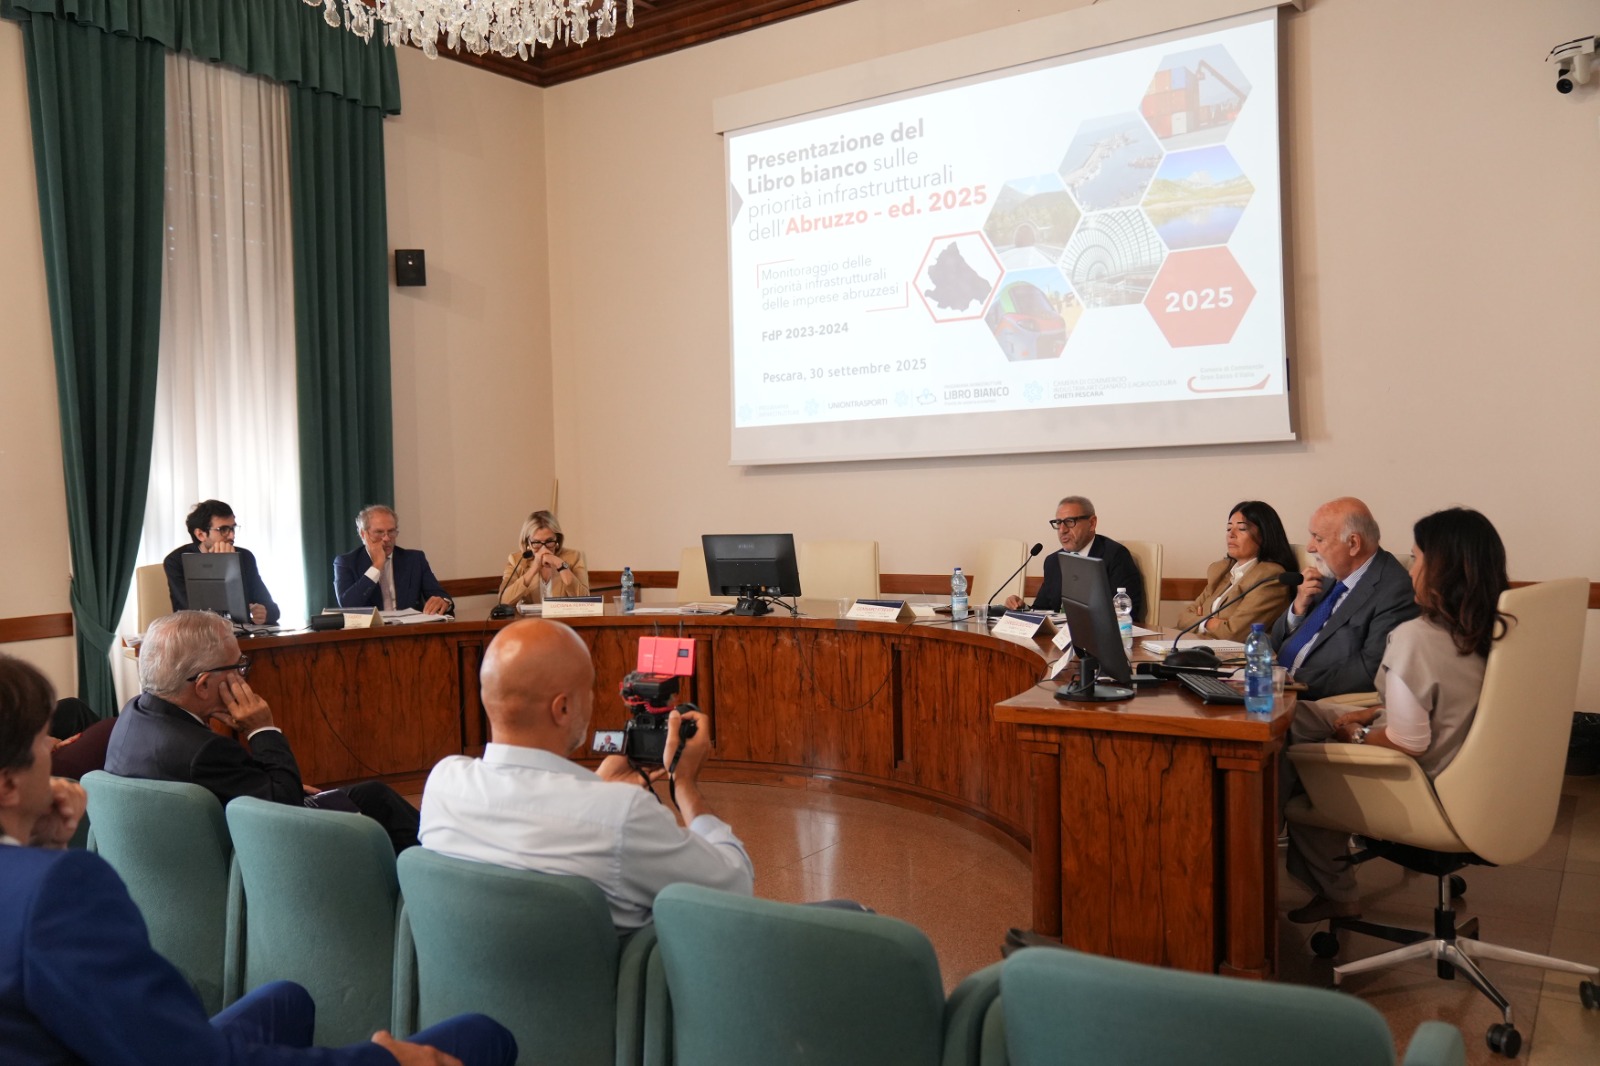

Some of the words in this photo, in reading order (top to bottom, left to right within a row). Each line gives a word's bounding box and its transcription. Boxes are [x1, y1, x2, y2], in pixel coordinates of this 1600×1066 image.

[747, 131, 885, 172] Presentazione
[891, 118, 924, 143] del
[748, 173, 795, 195] Libro
[801, 160, 868, 186] bianco
[873, 147, 919, 172] sulle
[748, 190, 812, 223] priorità
[818, 165, 953, 206] infrastrutturali
[888, 195, 922, 218] ed.
[928, 185, 988, 212] 2025
[761, 260, 839, 281] Monitoraggio
[842, 254, 872, 270] delle
[762, 281, 802, 299] priorità
[805, 268, 887, 290] infrastrutturali
[762, 296, 790, 311] delle
[792, 291, 839, 309] imprese
[842, 282, 899, 300] abruzzesi
[1165, 286, 1234, 313] 2025
[762, 330, 783, 342] FdP
[785, 322, 849, 340] 2023-2024
[763, 371, 807, 383] Pescara,
[810, 367, 824, 379] 30
[828, 362, 891, 378] settembre
[896, 358, 927, 372] 2025
[1088, 376, 1127, 385] COMMERCIO
[828, 399, 888, 410] UNIONTRASPORTI
[943, 388, 971, 400] LIBRO
[974, 386, 1009, 398] BIANCO
[1054, 392, 1074, 400] CHIETI
[1075, 391, 1104, 399] PESCARA
